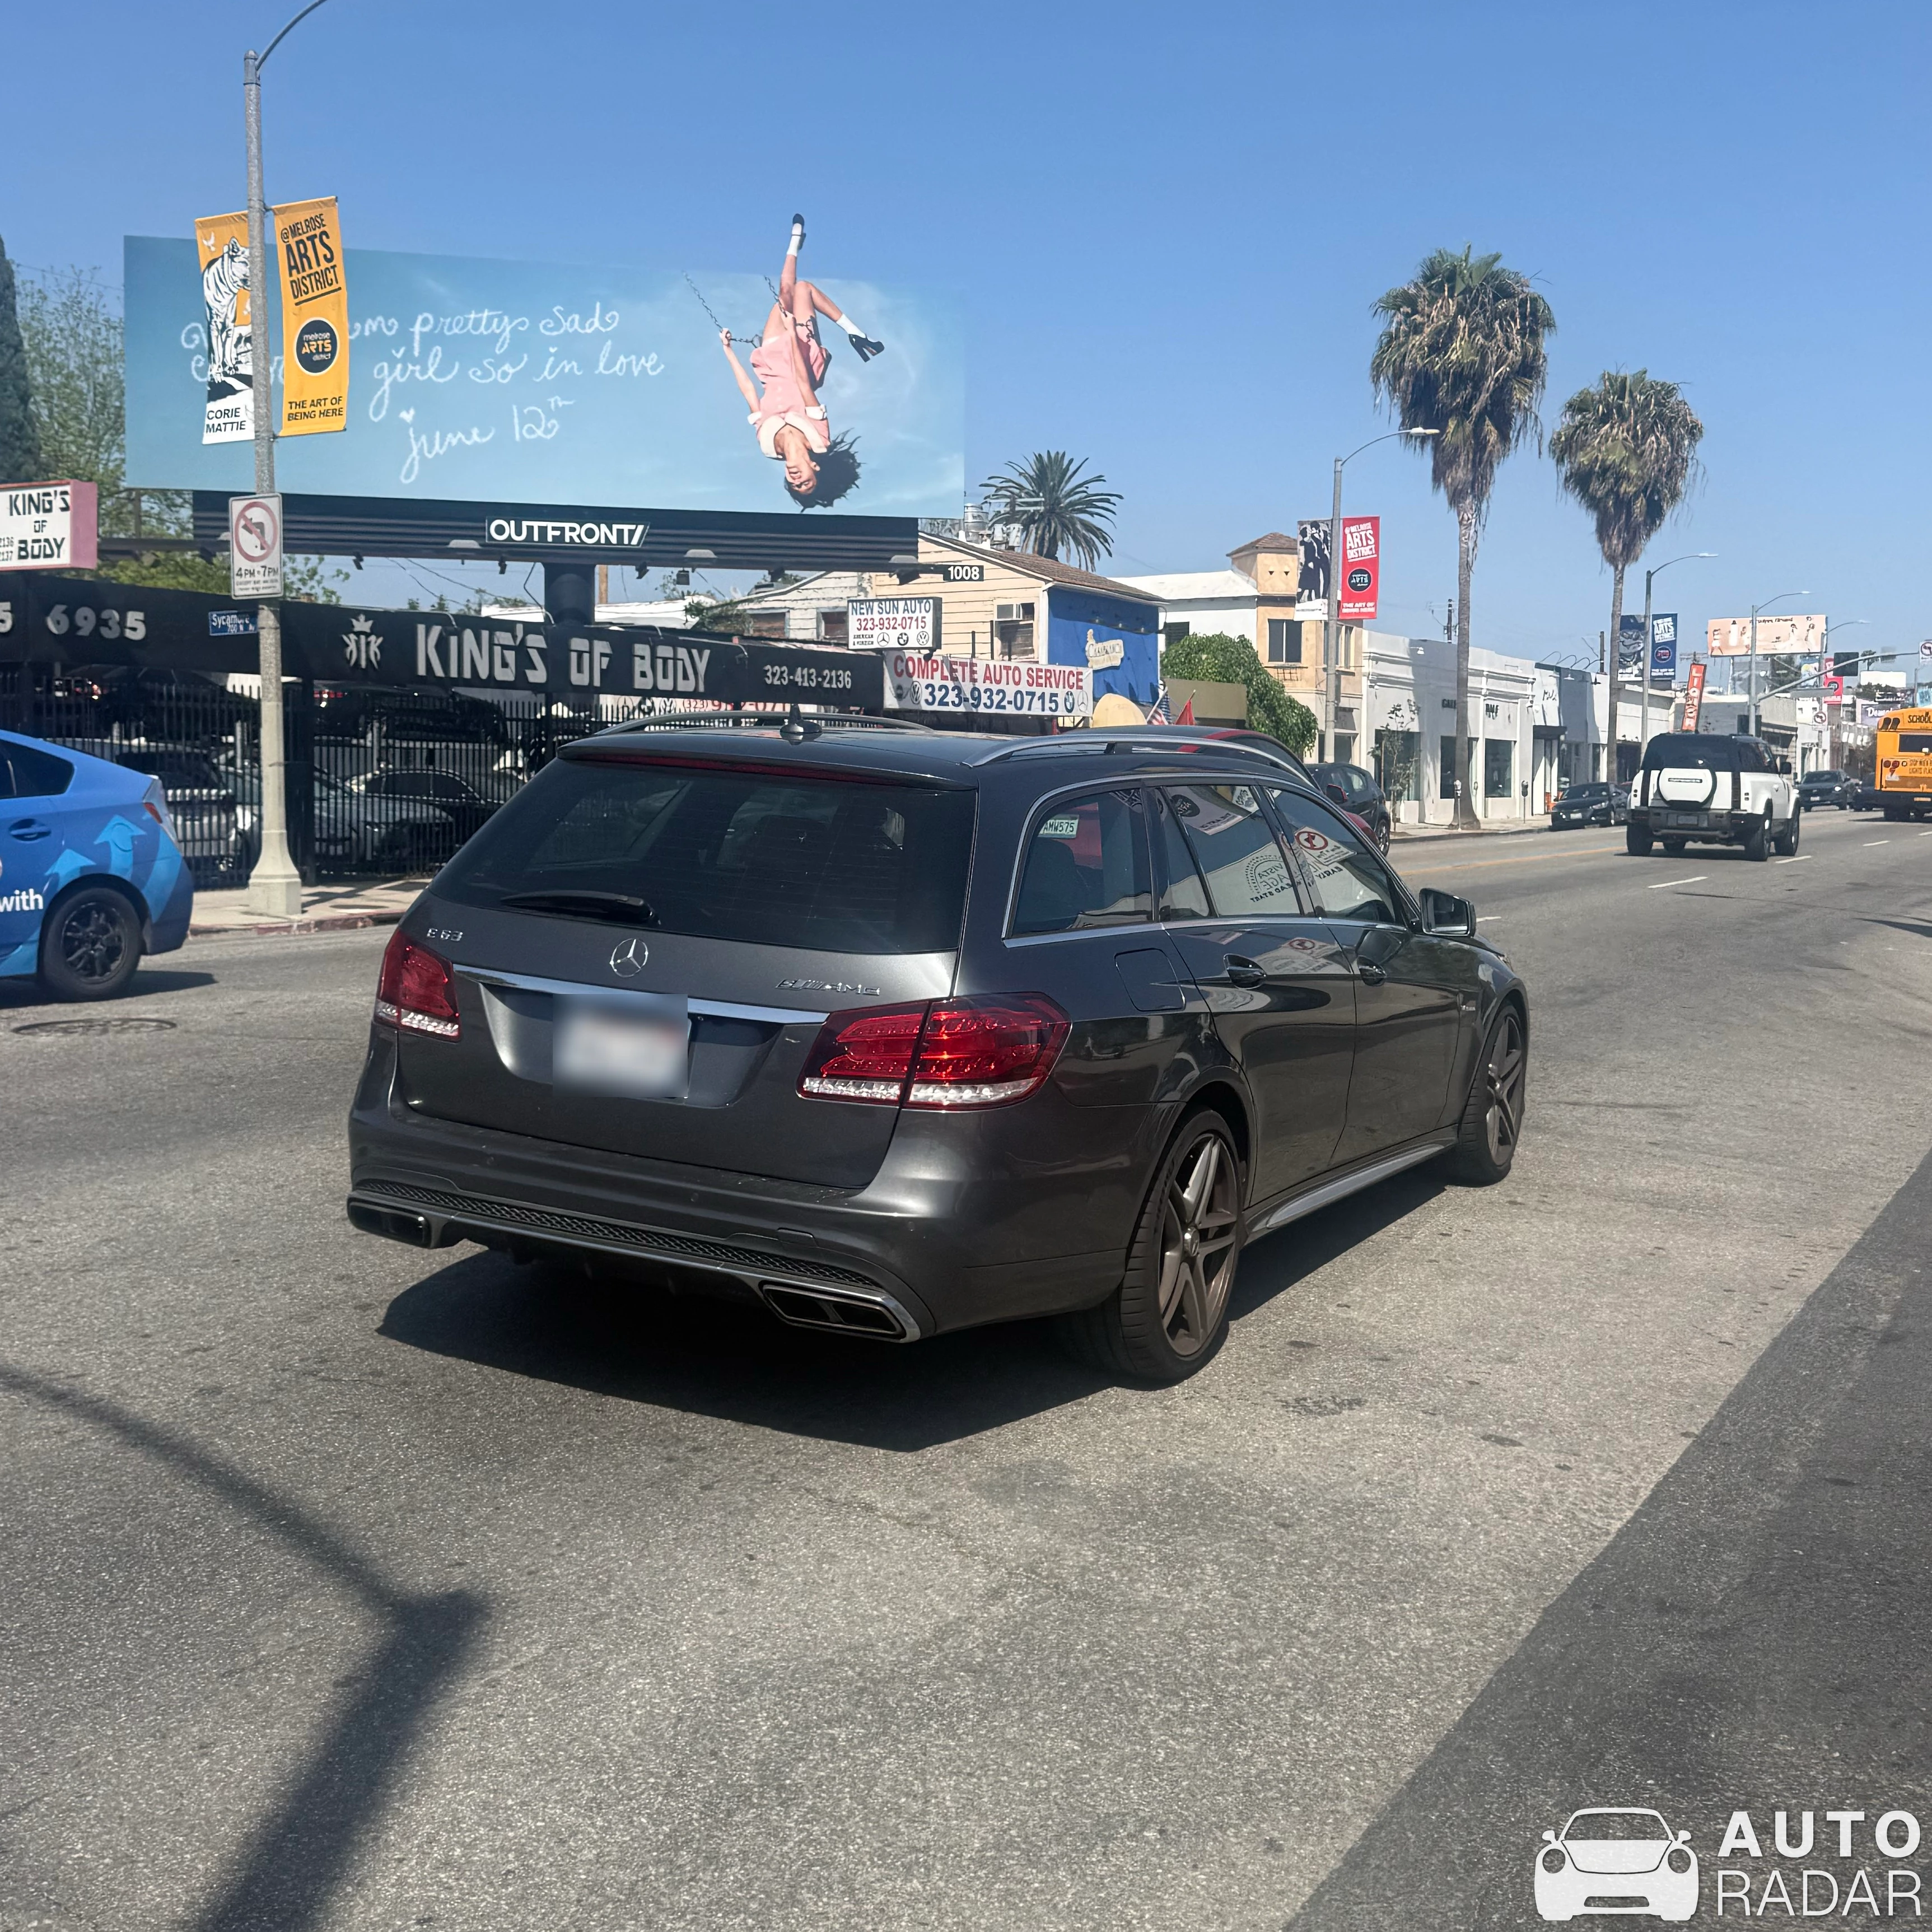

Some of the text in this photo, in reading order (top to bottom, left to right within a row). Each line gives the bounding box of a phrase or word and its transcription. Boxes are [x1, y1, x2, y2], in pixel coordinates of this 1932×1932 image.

[281, 213, 326, 243] @MELROSE
[286, 230, 334, 277] ARTS
[290, 264, 339, 300] DISTRICT
[409, 309, 529, 355] pretty
[301, 339, 332, 354] ARTS
[368, 346, 459, 423] girl
[533, 346, 584, 382] in
[594, 339, 665, 376] love
[207, 408, 241, 420] CORIE
[288, 396, 343, 410] THE ART OF
[288, 408, 343, 421] BEING HERE
[206, 421, 246, 433] MATTIE
[399, 407, 495, 483] june
[9, 490, 71, 516] KING'S
[34, 520, 48, 533] OF
[17, 537, 66, 559] BODY
[1346, 530, 1375, 549] ARTS
[1347, 545, 1376, 559] DISTRICT
[948, 566, 980, 580] 1008
[851, 599, 931, 615] NEW SUN AUTO
[0, 601, 146, 640] 5 6935
[1654, 622, 1674, 635] ARTS
[570, 638, 613, 687] OF
[632, 643, 710, 692] BODY
[893, 656, 1084, 690] COMPLETE AUTO SERVICE
[764, 664, 852, 689] 323-413-2136
[924, 683, 1059, 712] 323-932-0715
[1907, 715, 1932, 724] SCHOOL
[0, 889, 43, 912] with
[427, 928, 438, 938] E
